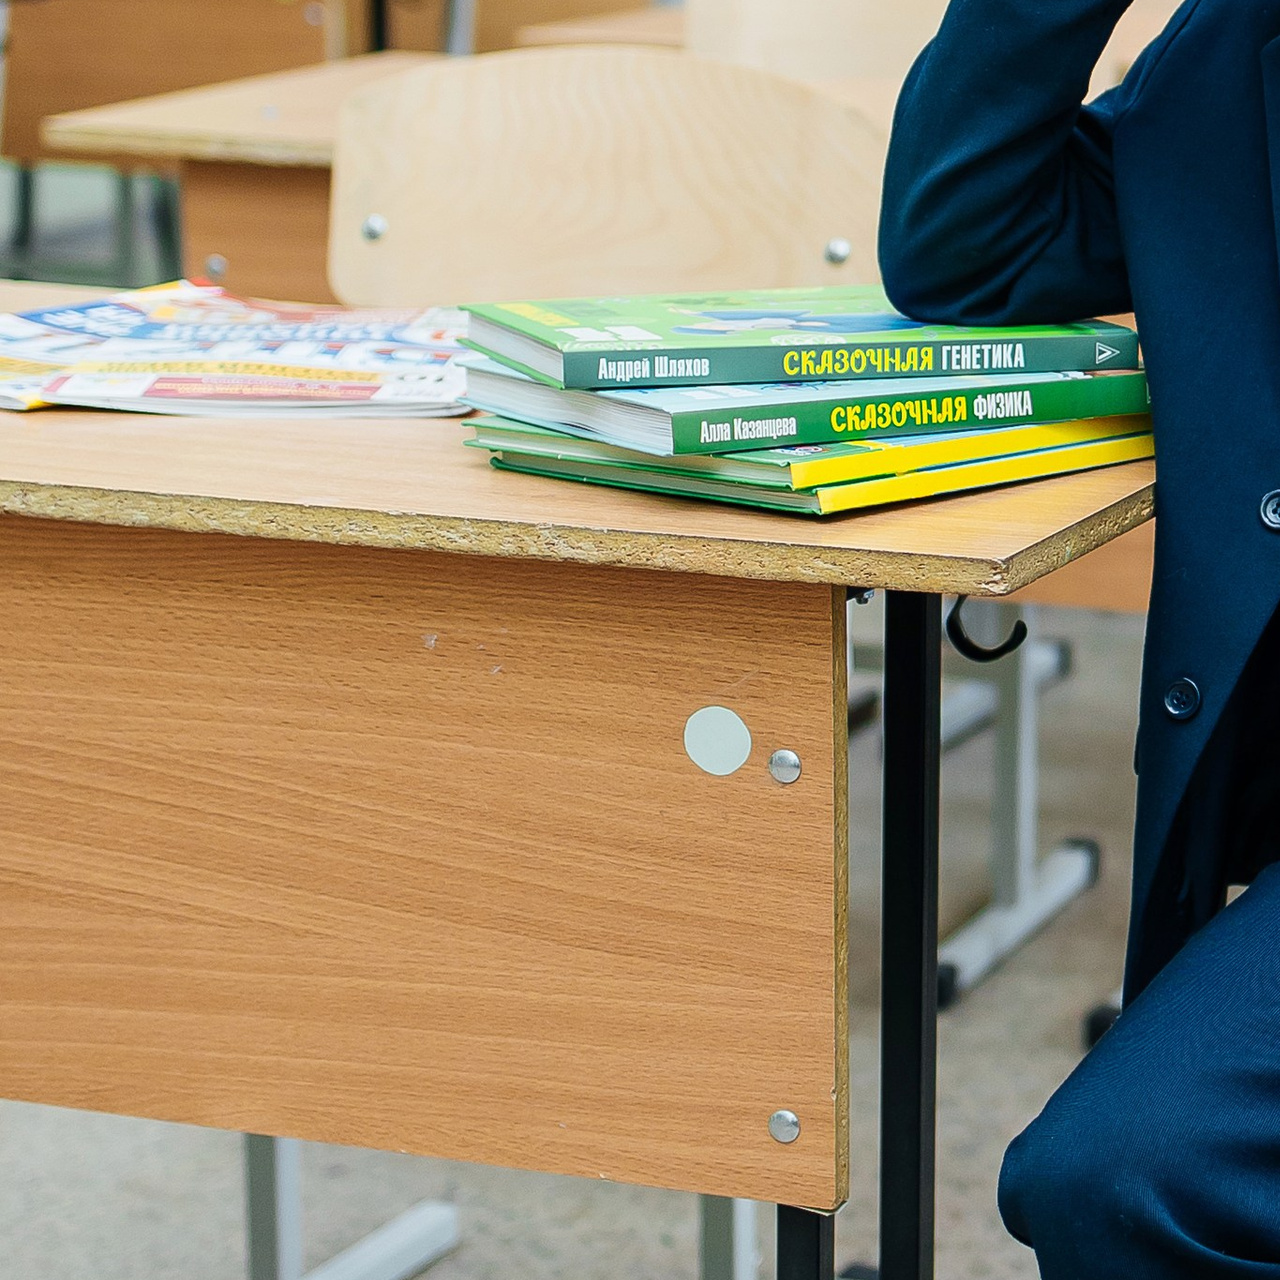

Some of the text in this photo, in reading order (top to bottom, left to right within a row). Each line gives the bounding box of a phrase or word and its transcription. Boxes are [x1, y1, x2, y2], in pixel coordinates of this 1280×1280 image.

[598, 355, 710, 382] Андрей Шляхов
[783, 342, 1025, 376] СКАЗОЧНАЯ ГЕНЕТИКА
[830, 390, 1033, 433] СКАЗОЧНАЯ ФИЗИКА
[700, 416, 797, 444] Алла Казанцева
